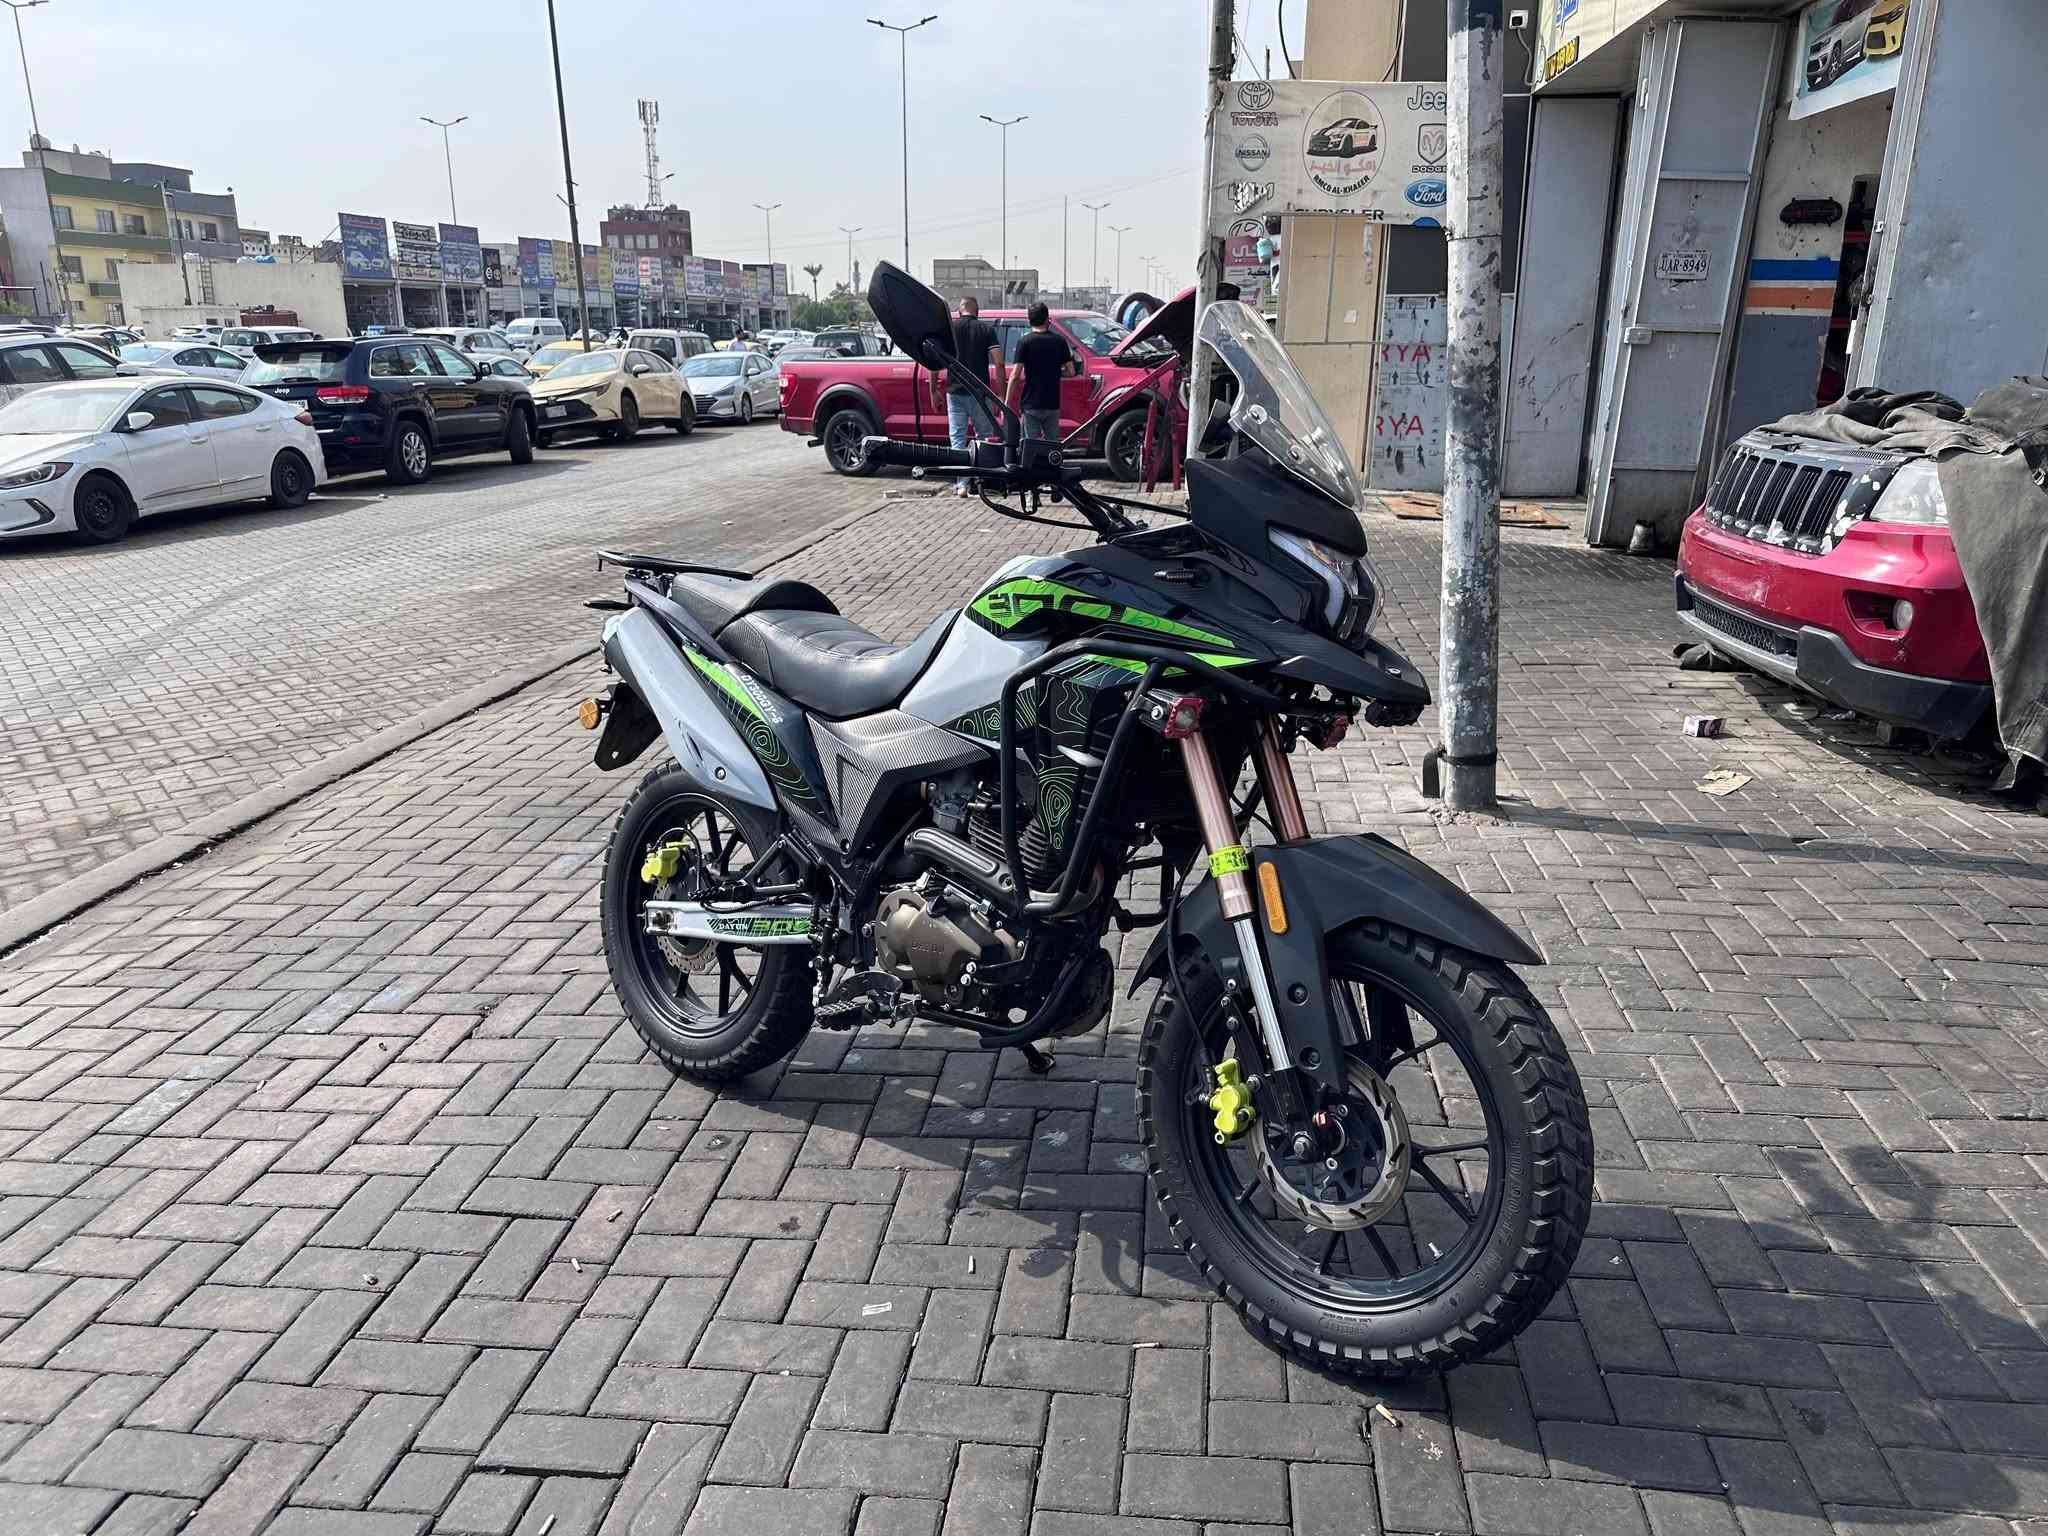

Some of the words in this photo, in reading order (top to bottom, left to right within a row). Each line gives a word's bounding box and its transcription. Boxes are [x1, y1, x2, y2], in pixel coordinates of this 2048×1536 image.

[1407, 85, 1447, 114] Jee
[1231, 111, 1279, 126] TOYOTA
[1238, 149, 1267, 158] NISSAN
[1414, 182, 1445, 202] Ford
[274, 387, 290, 395] Jeep
